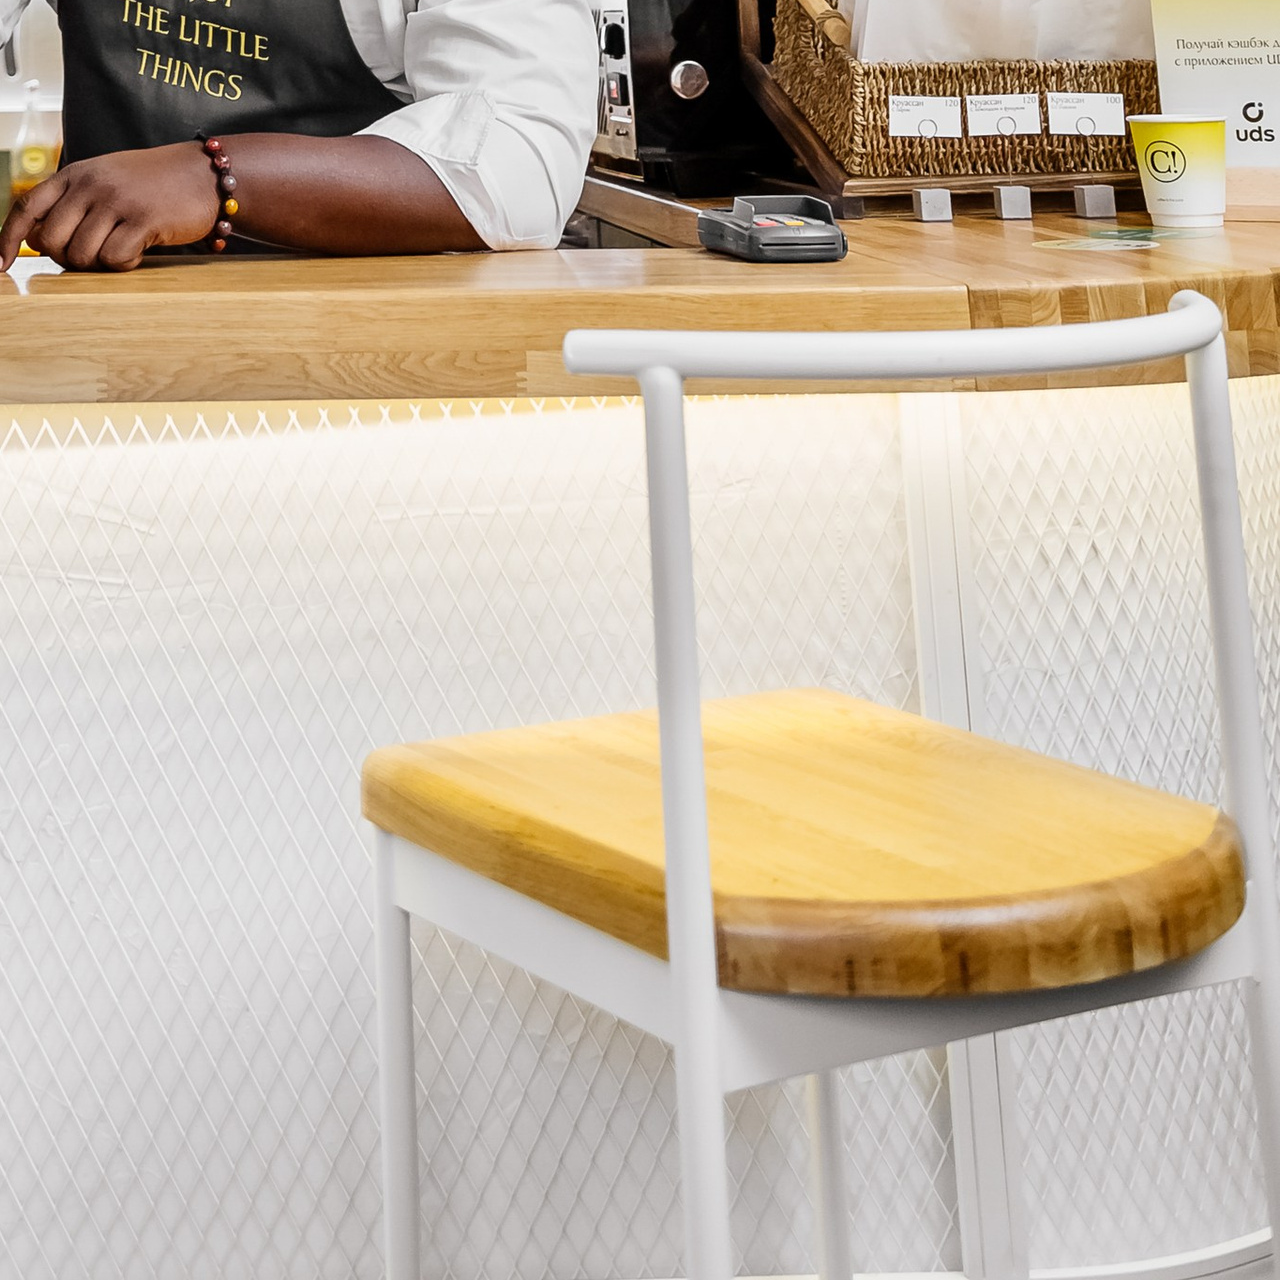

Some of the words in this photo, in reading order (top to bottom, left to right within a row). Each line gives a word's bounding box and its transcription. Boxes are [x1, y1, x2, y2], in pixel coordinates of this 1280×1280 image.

[179, 15, 269, 61] LITTLE
[1176, 38, 1224, 53] Получай
[1227, 37, 1270, 49] кэшбэк
[1174, 58, 1181, 67] с
[1184, 56, 1263, 70] приложением
[136, 48, 243, 101] THINGS
[892, 100, 924, 110] Круассан
[945, 99, 959, 107] 120
[970, 99, 1003, 109] Круассан
[1023, 96, 1037, 104] 120
[1051, 95, 1085, 106] Круассан
[1106, 96, 1121, 104] 100
[1235, 125, 1275, 143] uds
[1150, 149, 1179, 174] C!
